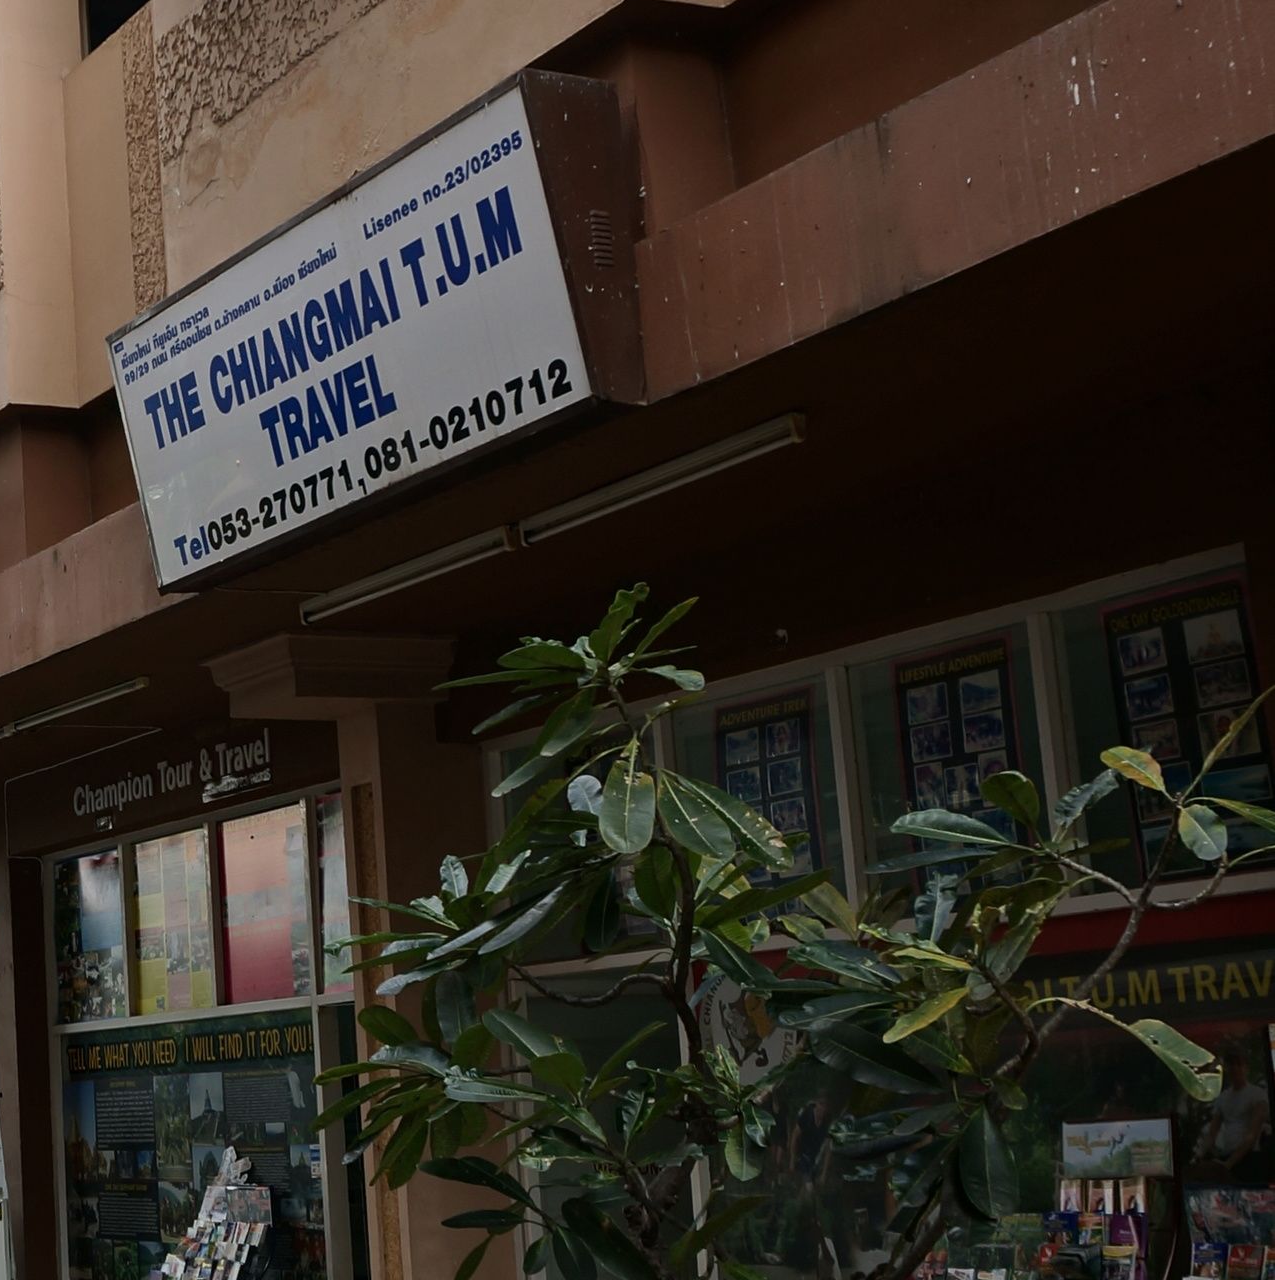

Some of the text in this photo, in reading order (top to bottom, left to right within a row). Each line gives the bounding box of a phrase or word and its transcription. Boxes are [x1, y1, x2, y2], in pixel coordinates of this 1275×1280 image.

[423, 130, 523, 206] no.23/02395
[144, 185, 523, 449] THE CHIANGMAI T.U.M
[259, 354, 398, 468] TRAVEL
[73, 772, 154, 816] Champion
[157, 759, 194, 793] Tour
[199, 748, 213, 782] &
[215, 727, 271, 776] Travel
[1167, 959, 1275, 1003] TRAV
[67, 1045, 86, 1070] TELL
[87, 1044, 101, 1069] ME
[103, 1042, 129, 1068] WHAT
[132, 1040, 150, 1066] YOU
[152, 1038, 177, 1065] NEED
[191, 1035, 216, 1062] WILL
[219, 1032, 243, 1060] FIND
[246, 1030, 257, 1057] IT
[259, 1028, 283, 1056] FOR
